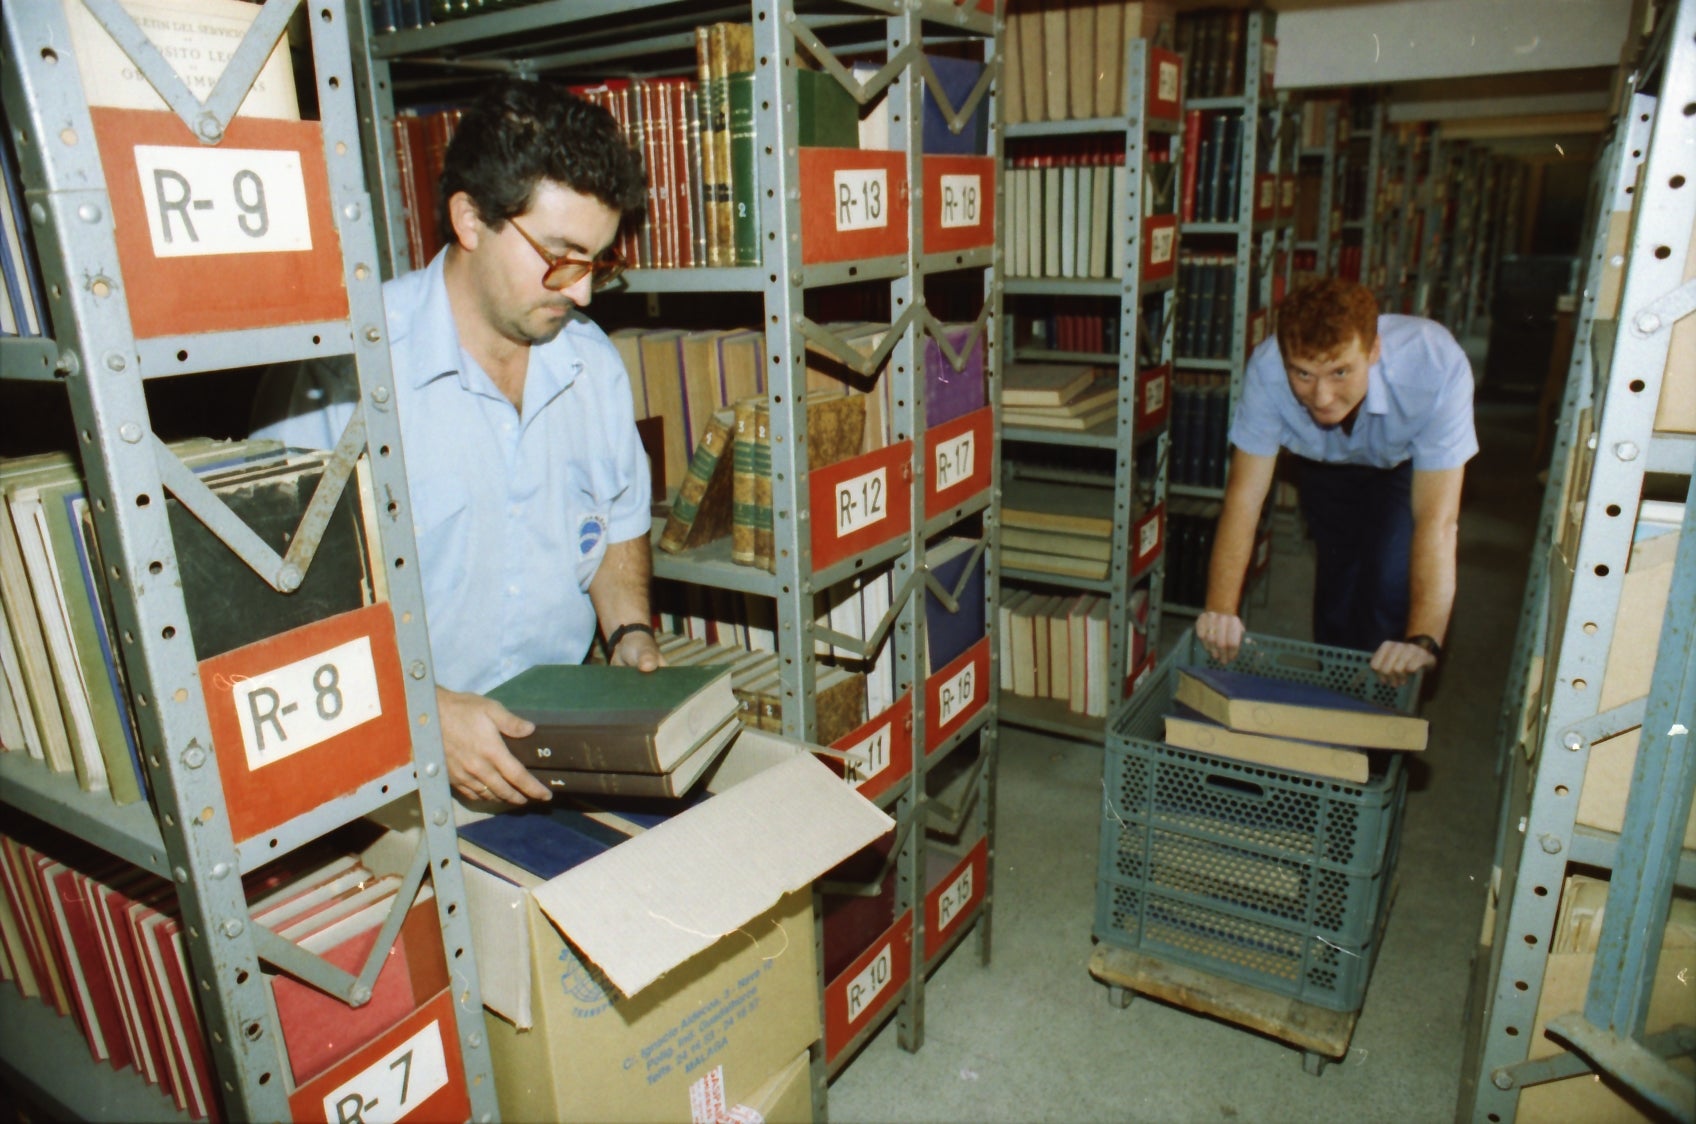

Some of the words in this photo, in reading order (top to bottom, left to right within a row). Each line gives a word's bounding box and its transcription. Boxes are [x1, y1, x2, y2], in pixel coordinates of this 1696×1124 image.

[153, 168, 270, 243] R-9
[839, 180, 881, 224] R-13
[944, 185, 976, 222] R-18
[937, 440, 970, 485] R-17
[840, 476, 882, 528] R-12
[248, 663, 344, 751] R-8
[942, 671, 972, 720] R-16
[942, 873, 970, 925] R-15
[851, 956, 887, 1015] R-10
